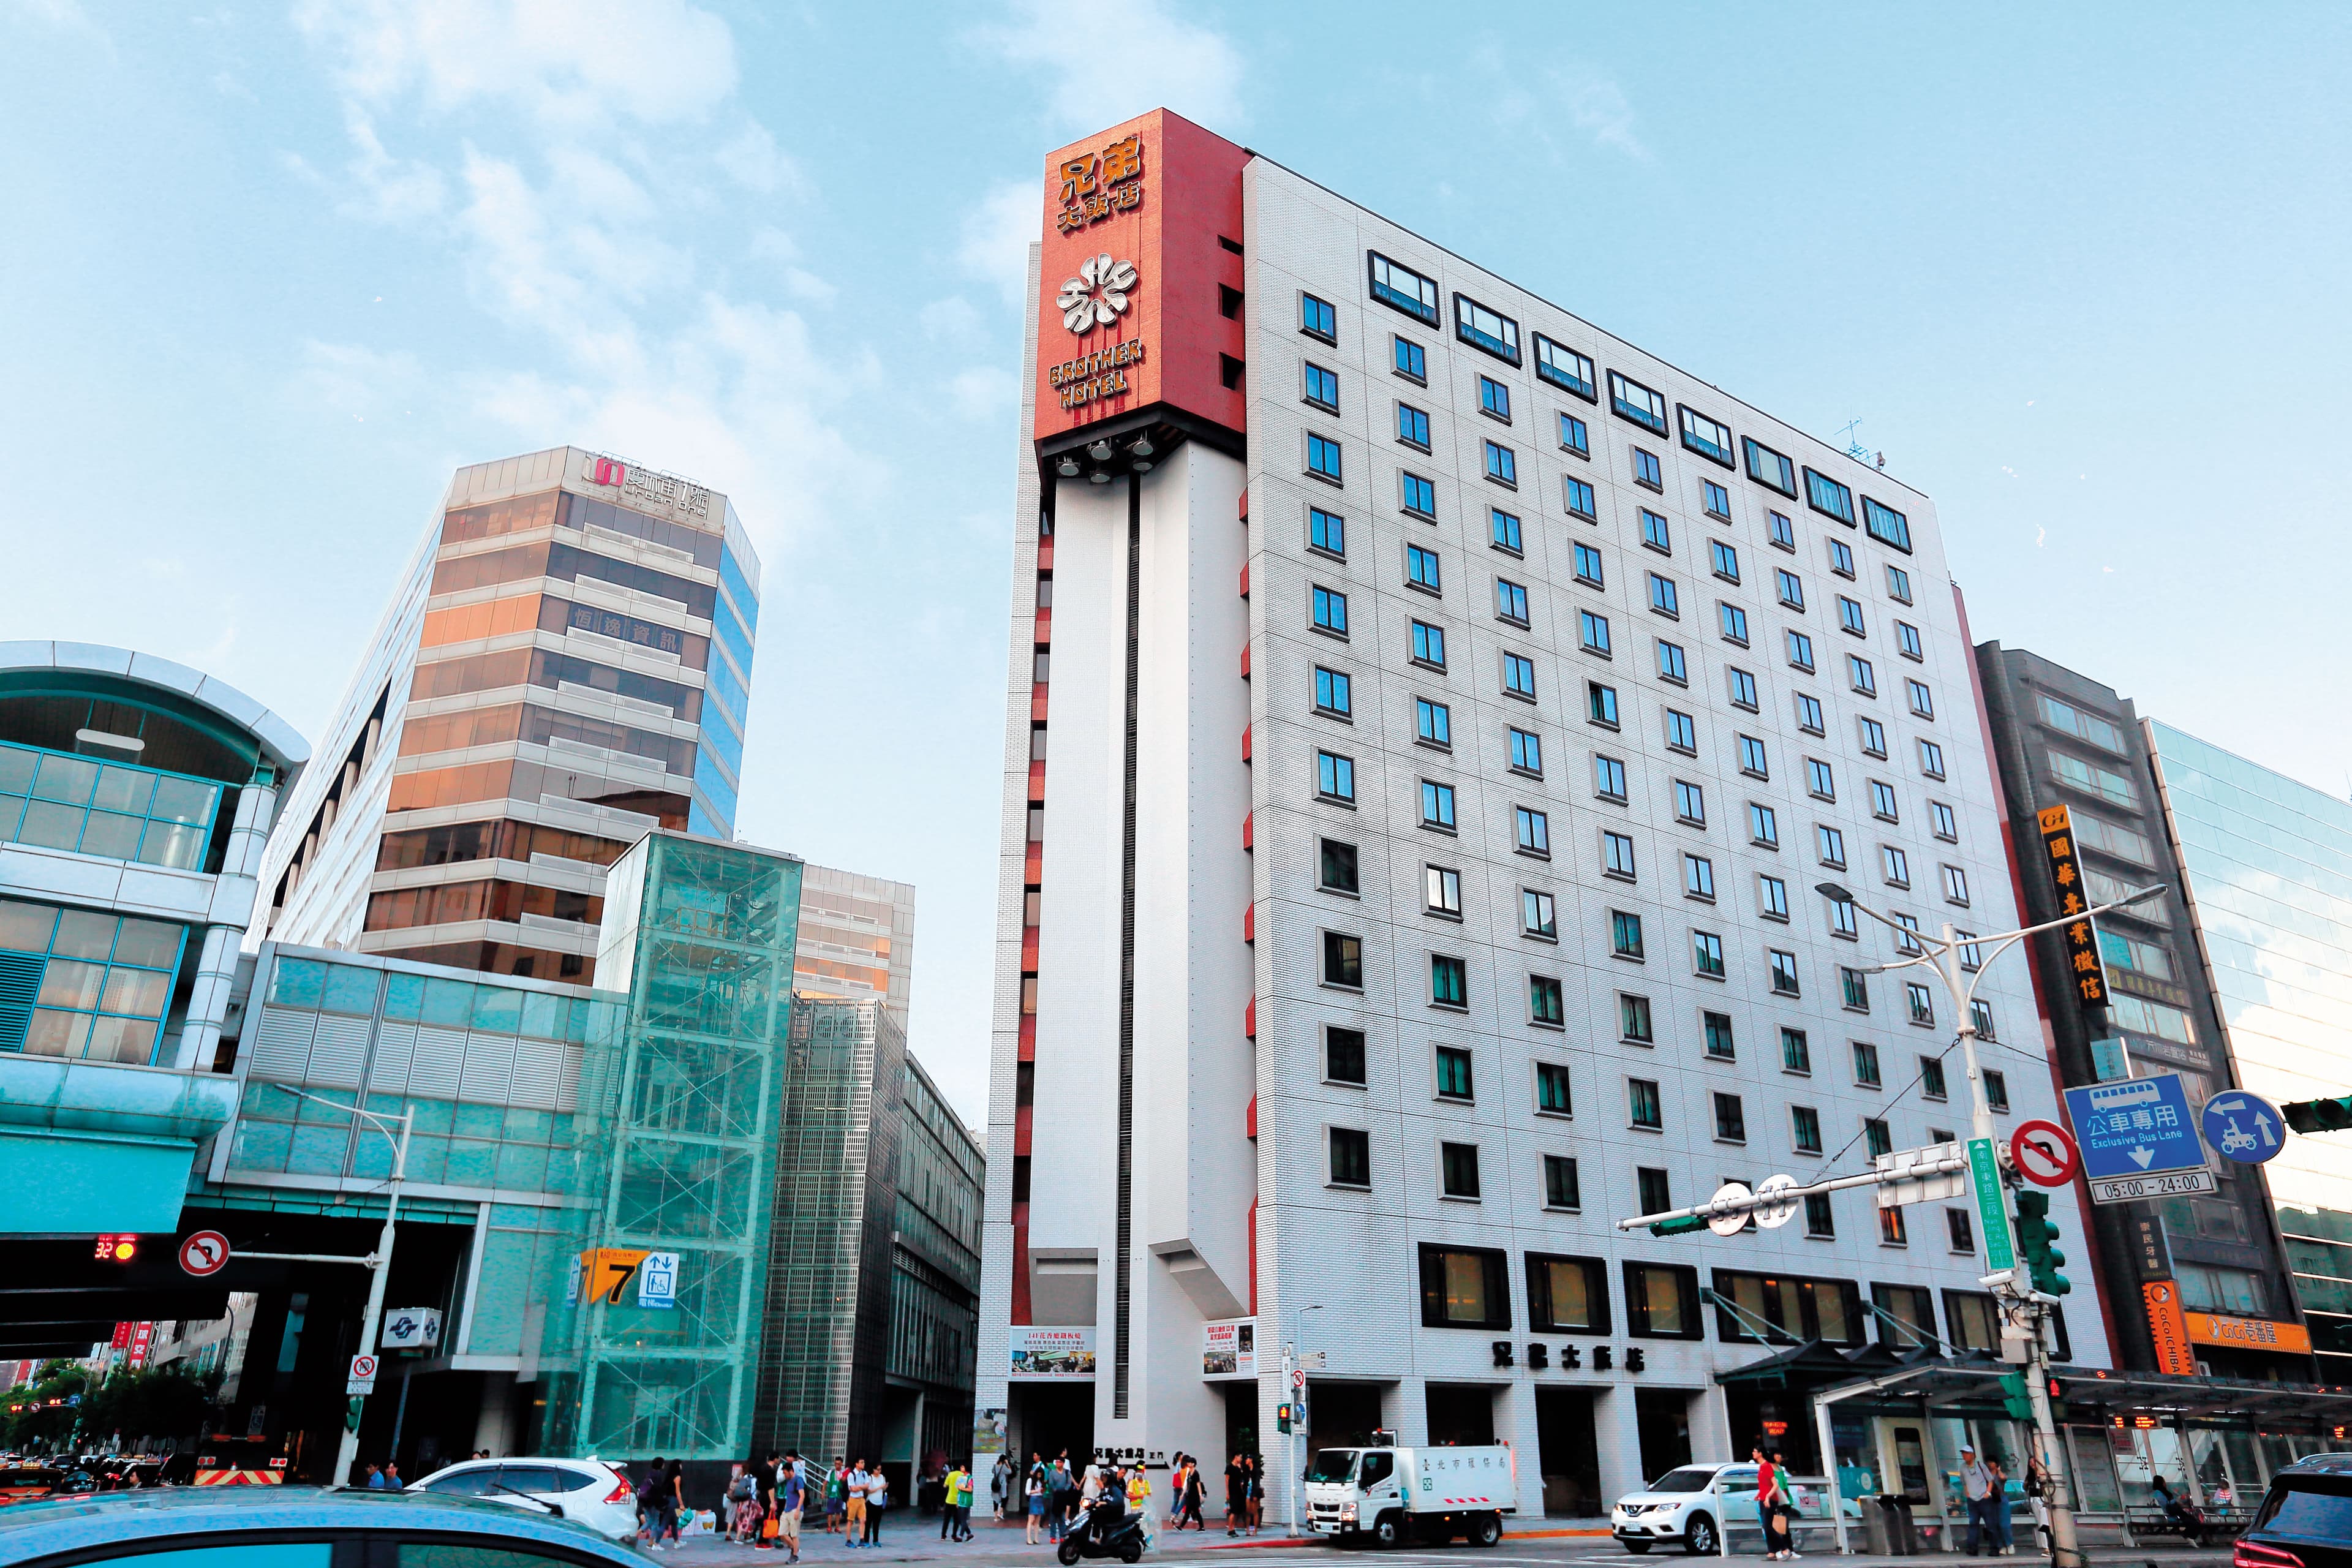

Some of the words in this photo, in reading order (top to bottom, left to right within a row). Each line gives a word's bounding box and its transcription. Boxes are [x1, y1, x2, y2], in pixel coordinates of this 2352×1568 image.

[1058, 136, 1140, 204] 兄弟
[1057, 181, 1140, 232] 大飯店
[1049, 337, 1142, 386] BROTHER
[1060, 369, 1128, 410] HOTEL
[2087, 1104, 2179, 1136] 公車專用
[2091, 1136, 2136, 1148] Exclusive
[2139, 1133, 2157, 1143] Bus
[2160, 1130, 2182, 1140] Lane
[1977, 1151, 1999, 1216] 南京東路三段
[2105, 1181, 2144, 1198] 05:00
[2158, 1175, 2199, 1193] 24:00
[95, 1242, 113, 1259] 32
[608, 1264, 637, 1303] 7
